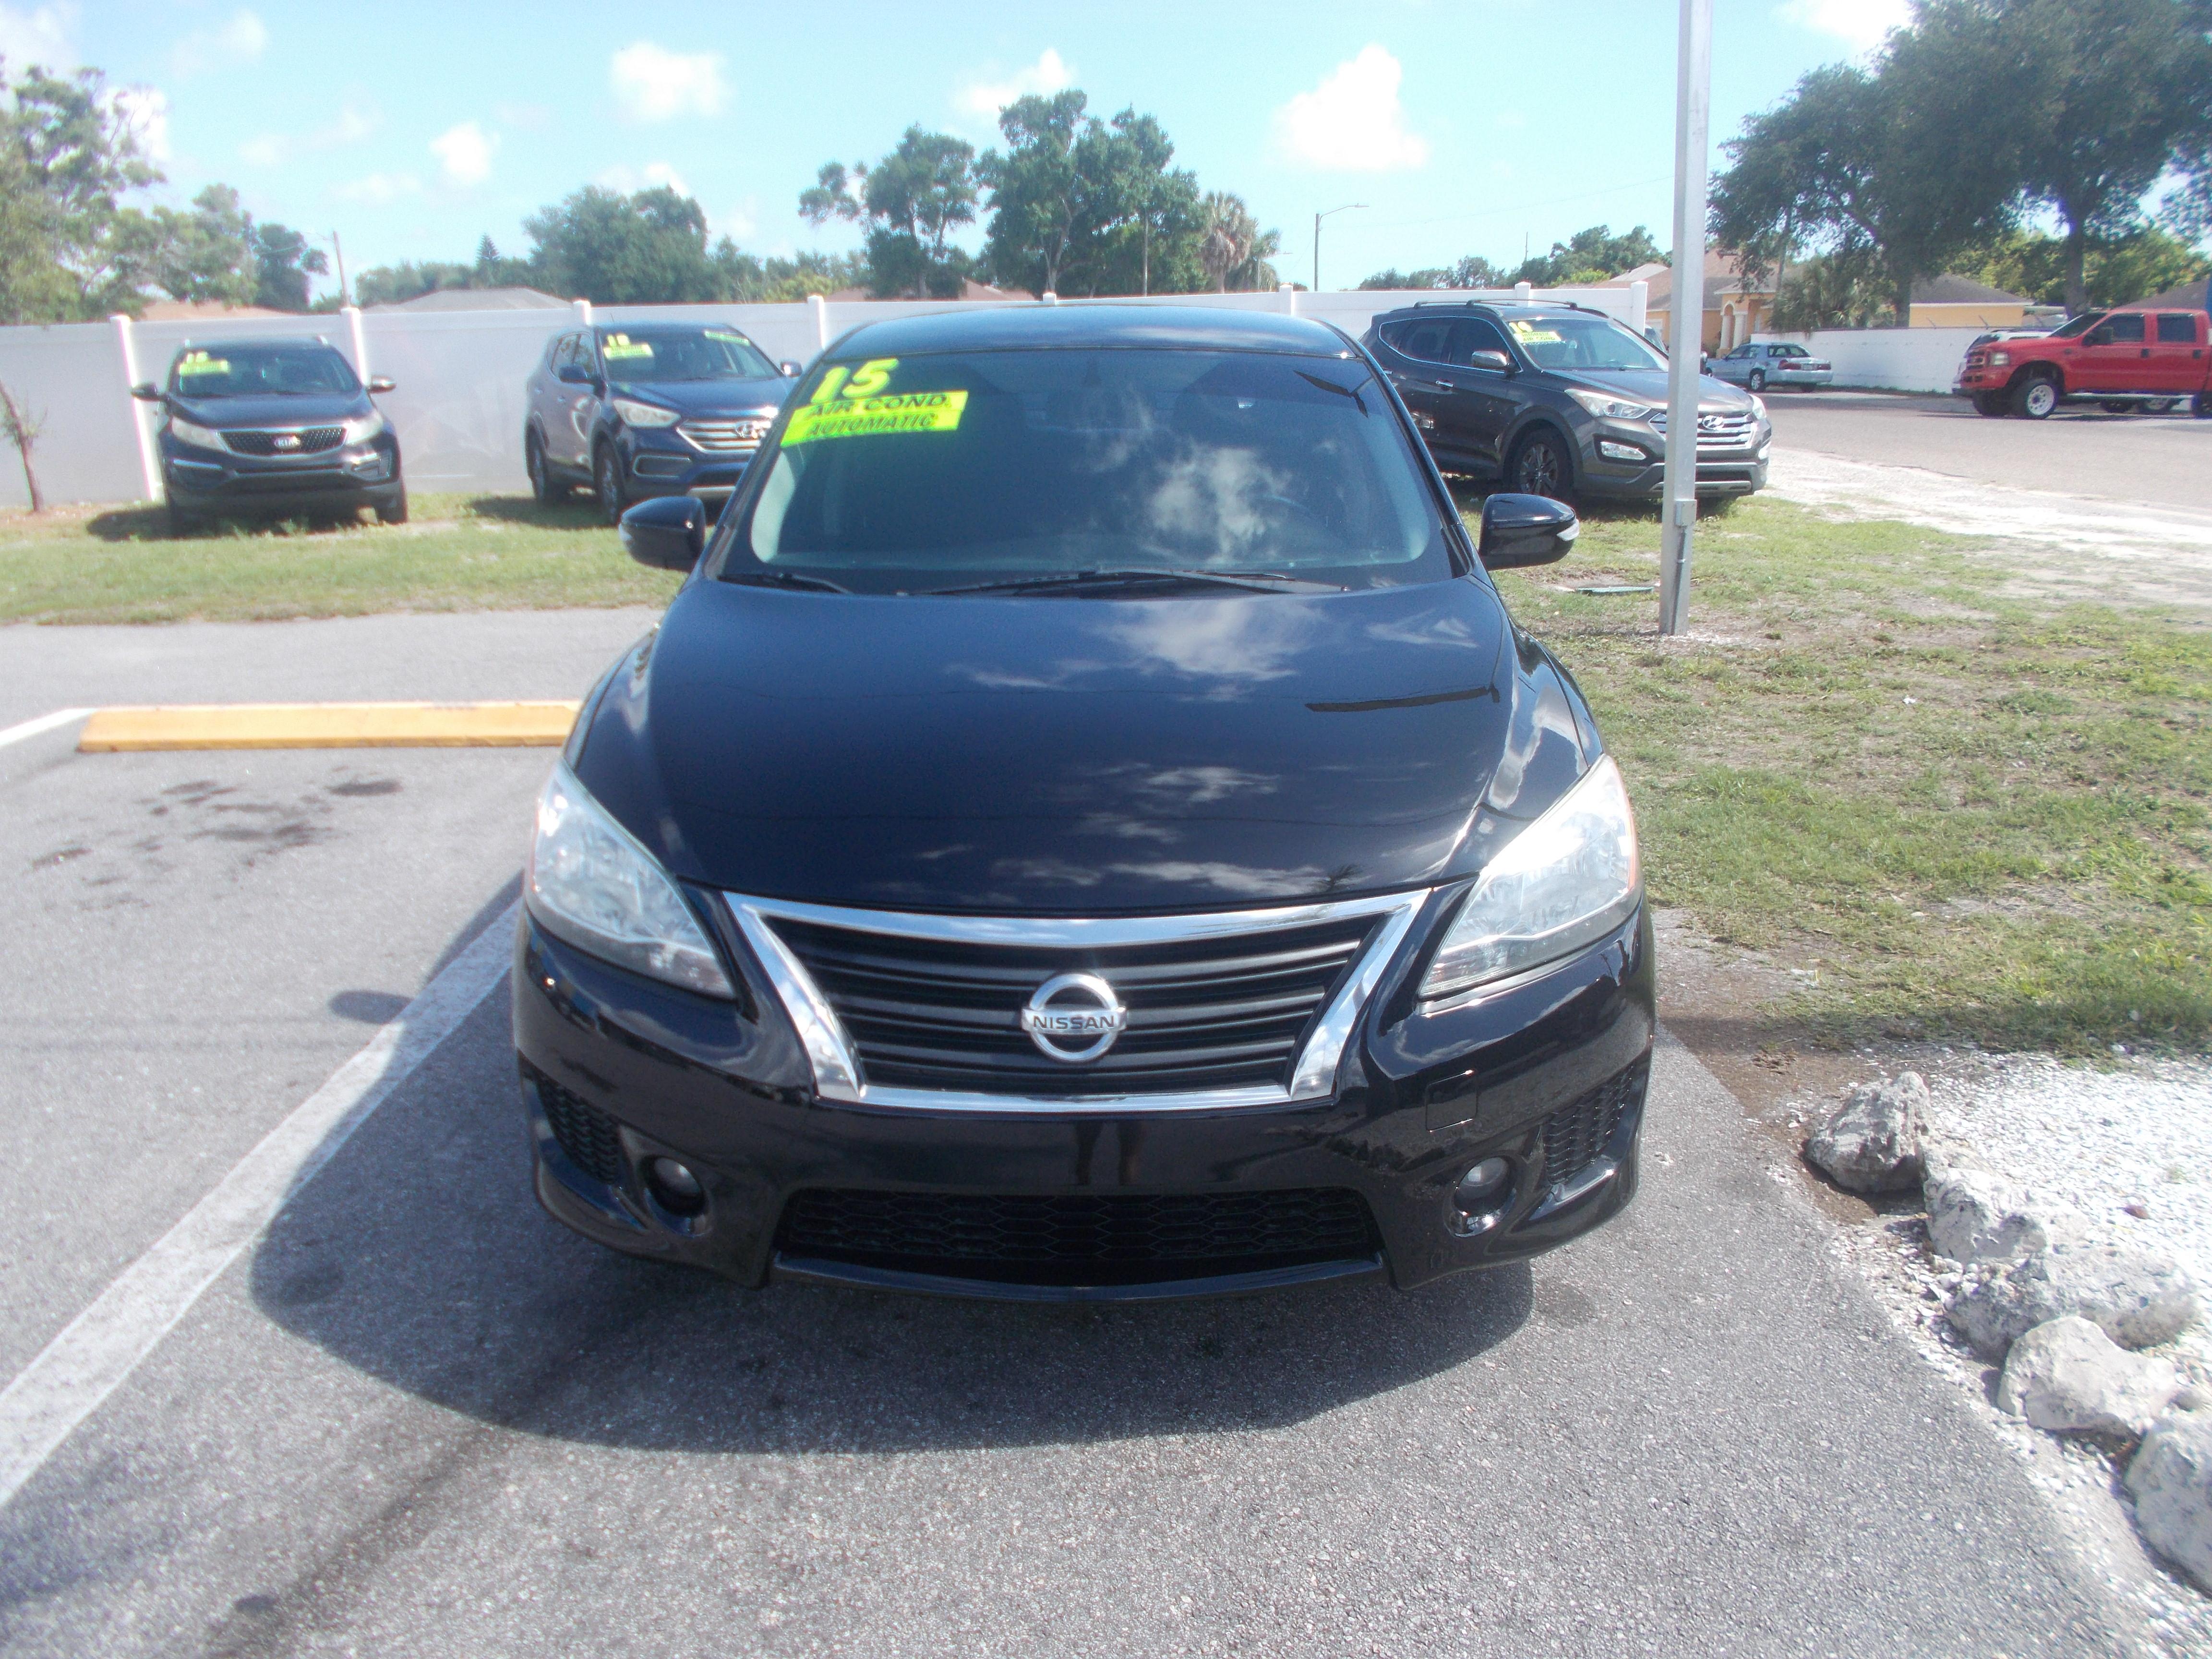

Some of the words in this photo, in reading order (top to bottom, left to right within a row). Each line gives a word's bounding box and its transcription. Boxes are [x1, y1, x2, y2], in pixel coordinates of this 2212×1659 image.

[810, 358, 899, 404] 15
[809, 399, 854, 417] AIR
[807, 412, 937, 436] AUTOMATIC
[1033, 1015, 1114, 1030] NISSAN
